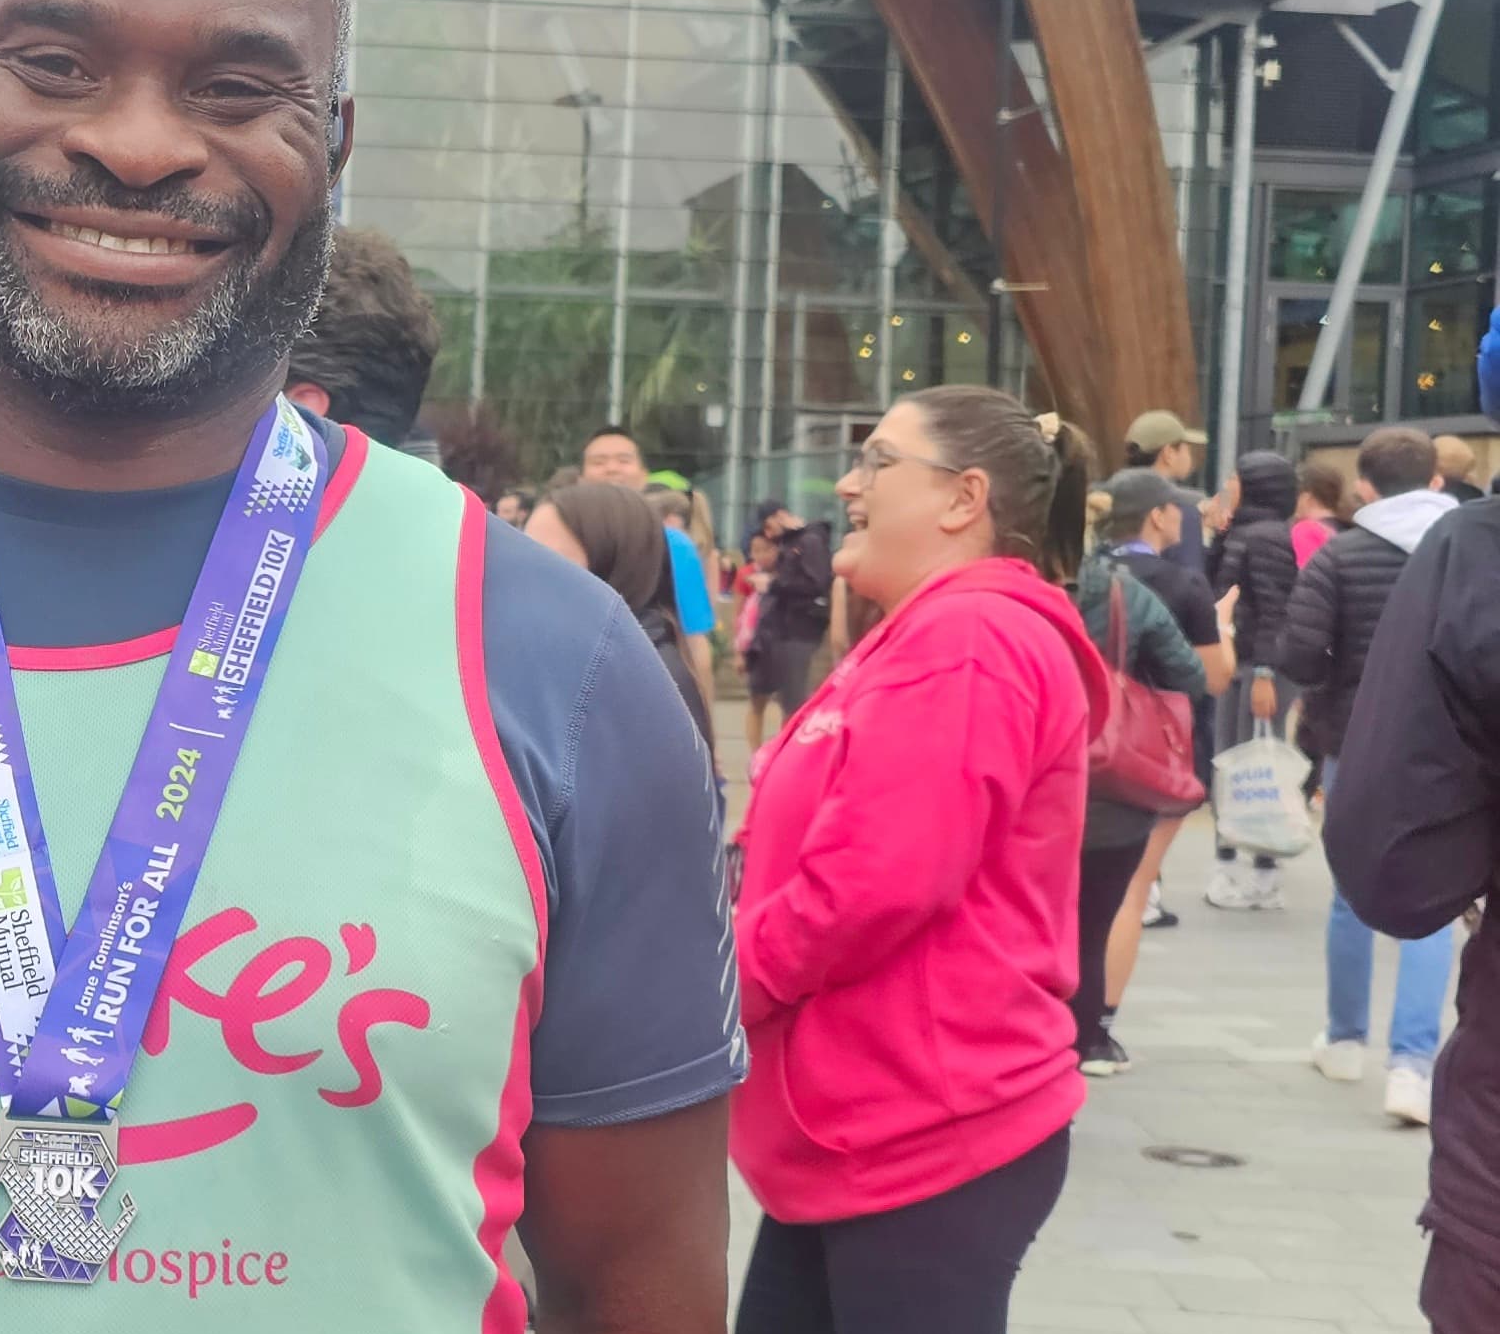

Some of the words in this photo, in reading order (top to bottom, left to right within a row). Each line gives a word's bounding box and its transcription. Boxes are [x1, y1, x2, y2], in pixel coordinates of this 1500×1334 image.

[197, 601, 225, 650] Sheffield
[210, 612, 236, 654] Mutual
[222, 573, 276, 683] SHEFFIELD
[260, 533, 292, 573] 10K
[155, 748, 202, 822] 2024
[141, 842, 180, 893] ALL
[10, 908, 49, 999] Sheffield
[74, 975, 99, 1016] Jane
[89, 880, 134, 974] Tomlinson's
[116, 896, 161, 956] FOR
[92, 957, 138, 1025] RUN
[19, 1149, 94, 1166] SHEFFIELD
[28, 1165, 102, 1199] 10K
